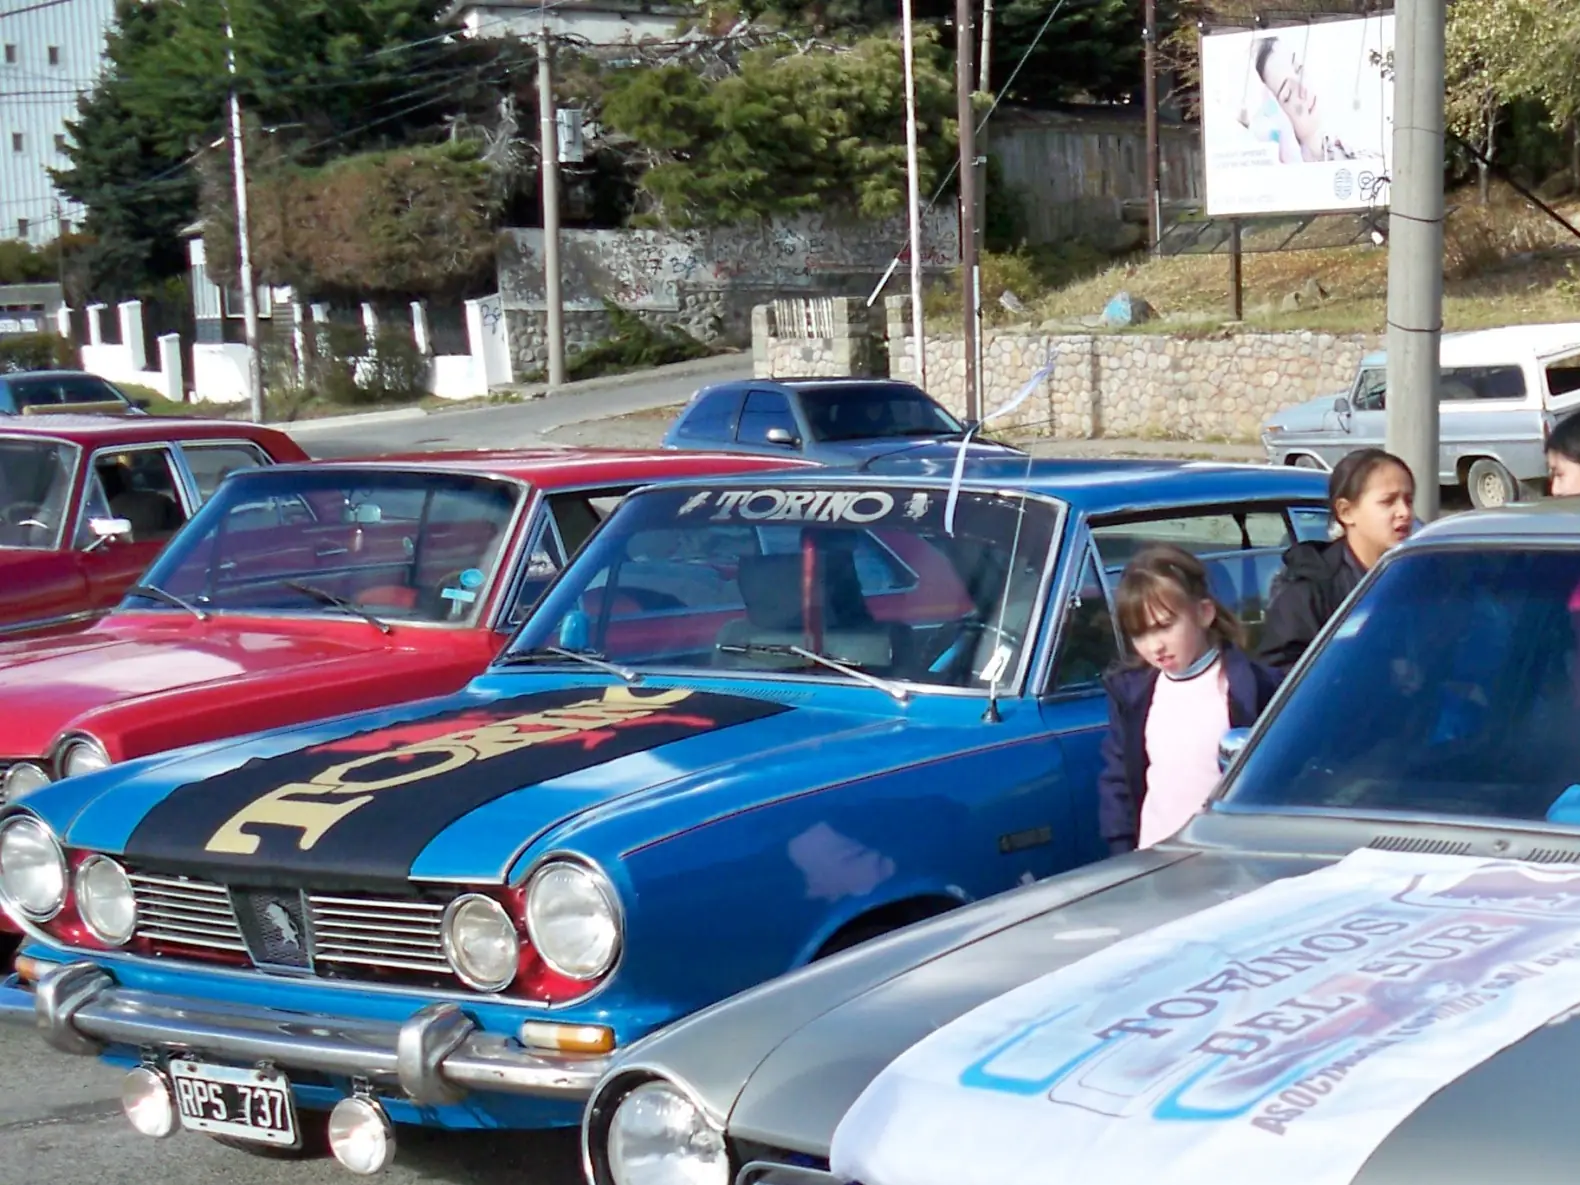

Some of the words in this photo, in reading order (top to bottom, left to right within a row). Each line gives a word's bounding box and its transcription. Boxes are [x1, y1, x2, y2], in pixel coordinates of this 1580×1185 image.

[708, 488, 895, 523] TORINO
[205, 685, 695, 855] TORINO
[1093, 917, 1409, 1041] TORINOS
[1190, 992, 1357, 1061] DEL
[1357, 922, 1515, 978] SUR
[177, 1078, 228, 1121] RPS
[237, 1085, 284, 1129] 737
